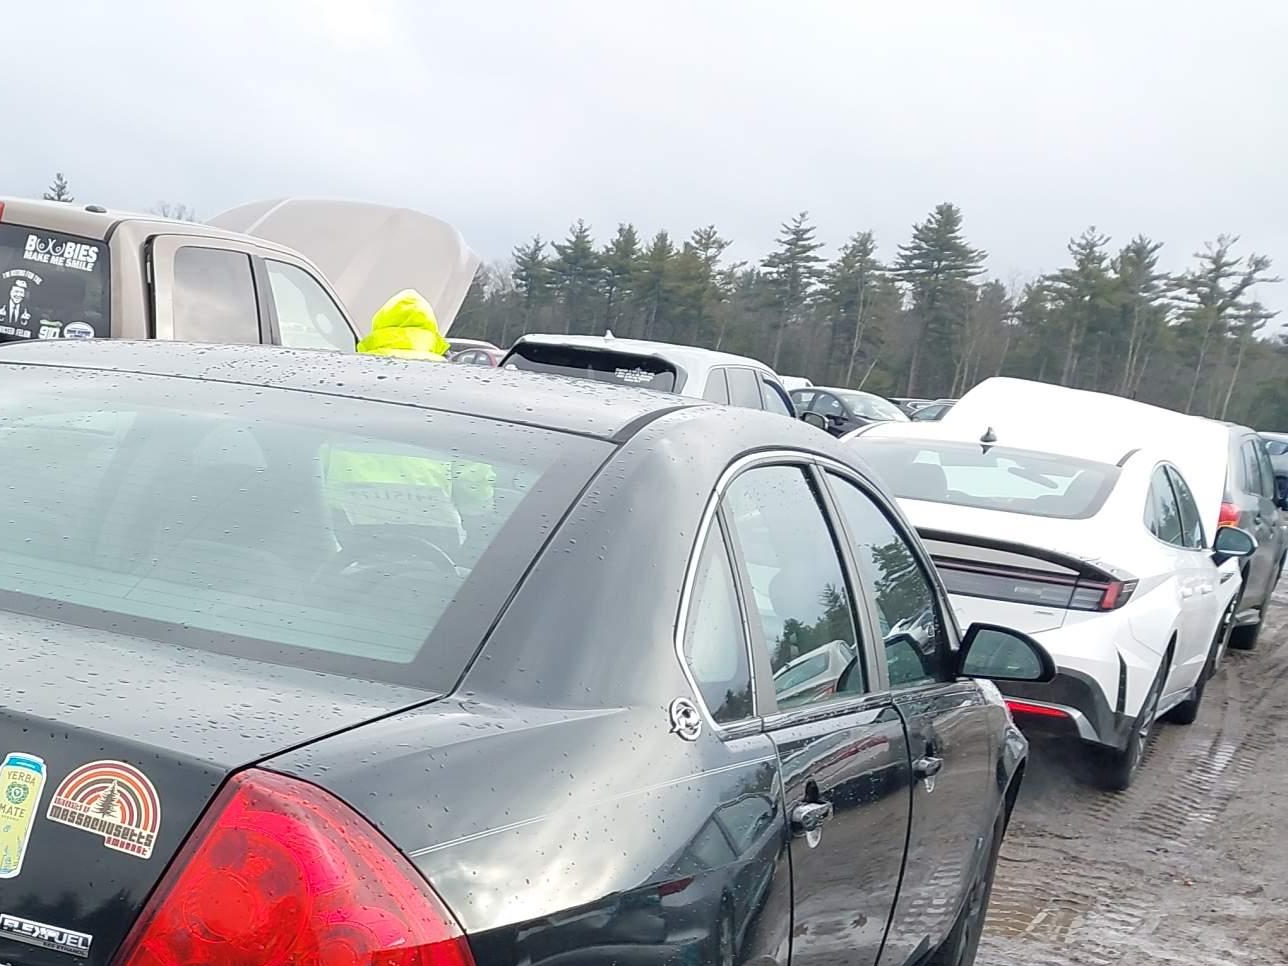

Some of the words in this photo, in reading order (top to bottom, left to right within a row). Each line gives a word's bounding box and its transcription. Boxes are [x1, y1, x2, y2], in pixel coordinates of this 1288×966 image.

[24, 250, 50, 262] MAKE
[50, 255, 65, 266] ME
[65, 258, 94, 271] SMILE
[6, 771, 36, 787] YERBA
